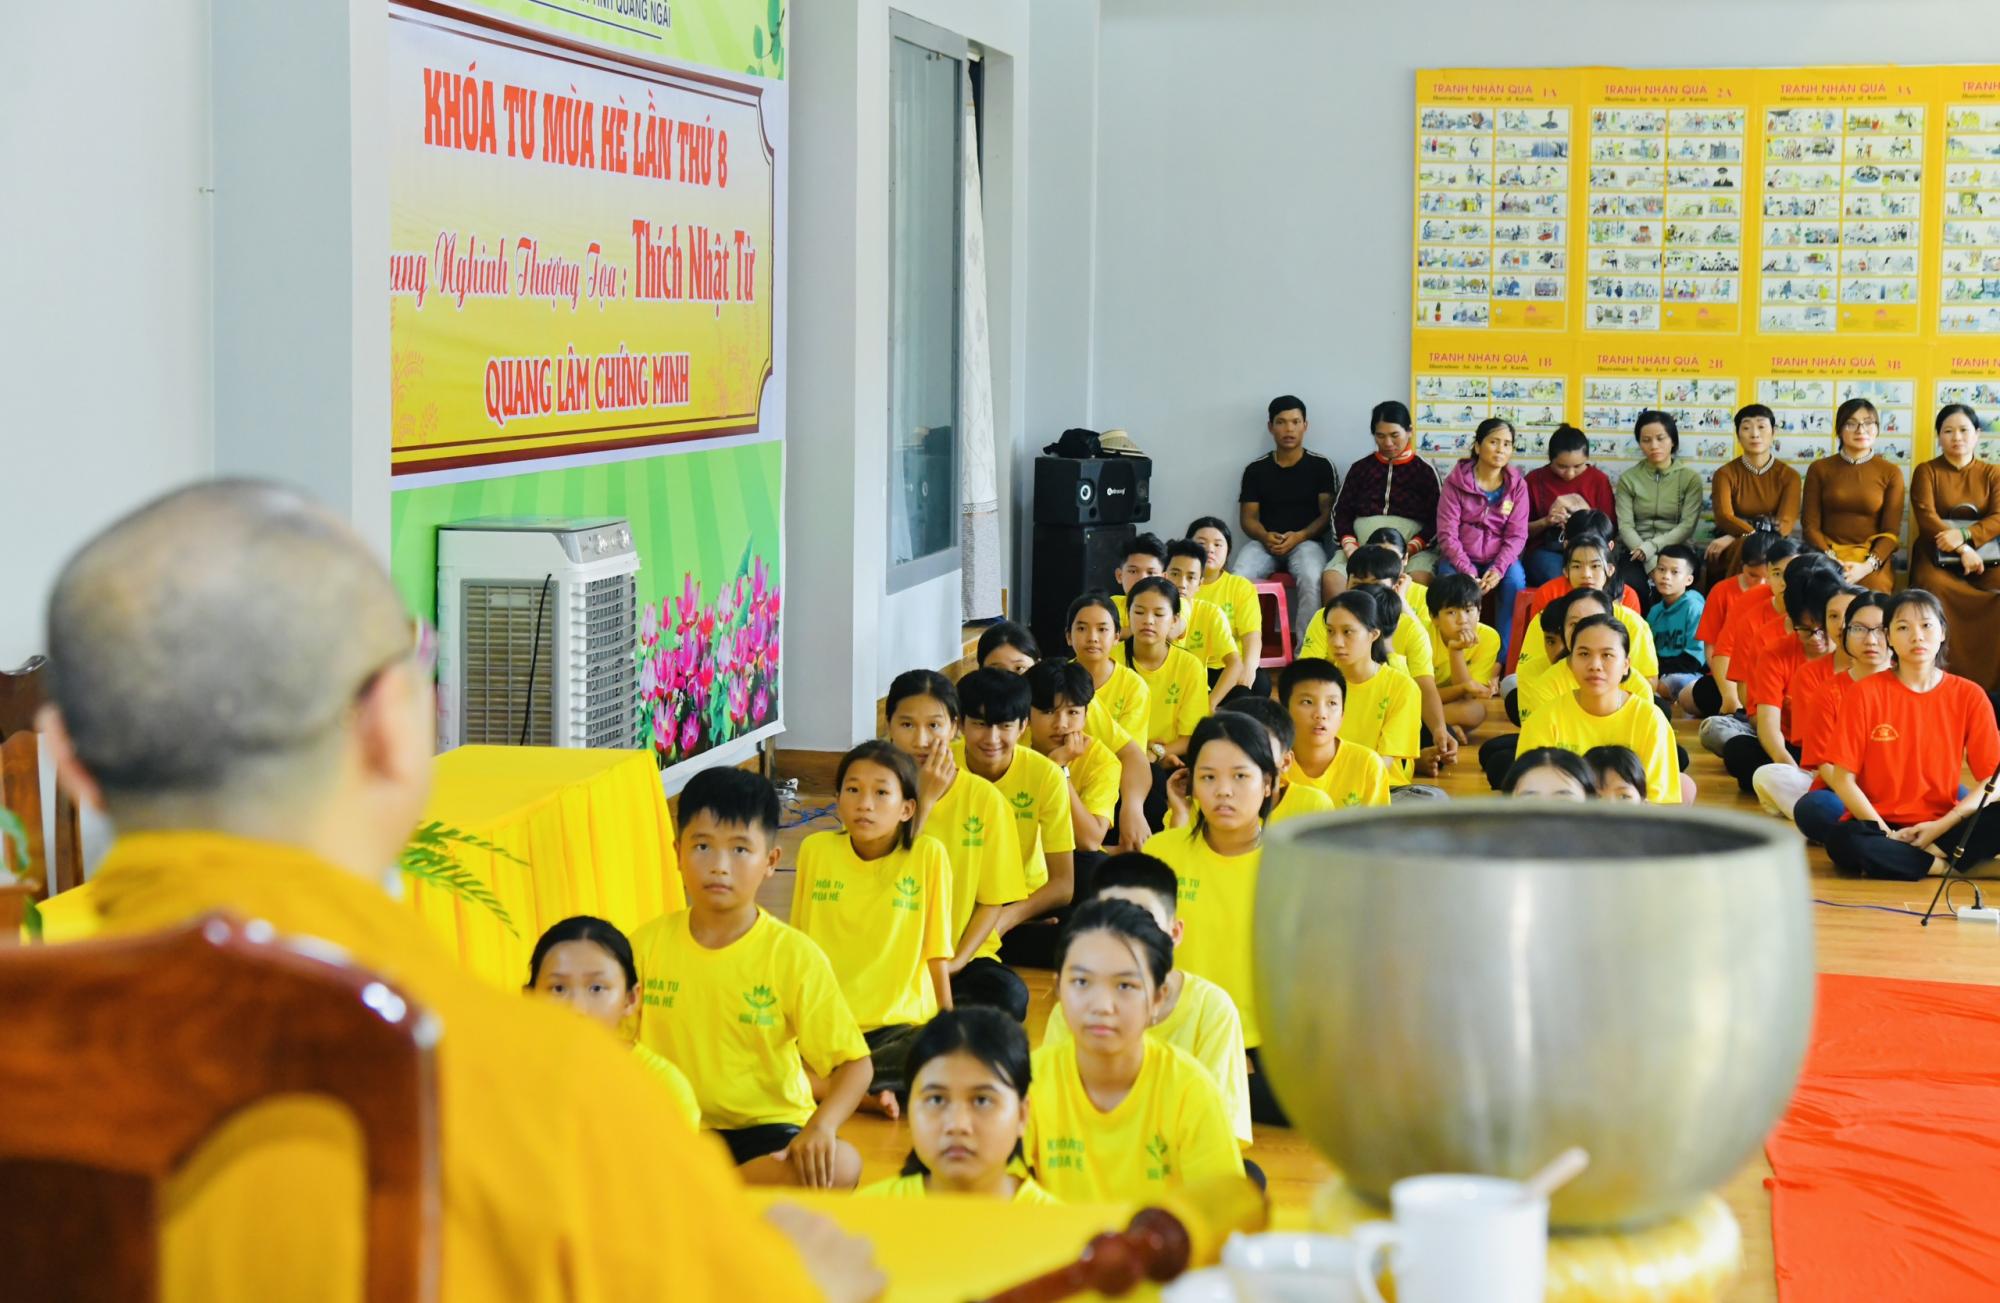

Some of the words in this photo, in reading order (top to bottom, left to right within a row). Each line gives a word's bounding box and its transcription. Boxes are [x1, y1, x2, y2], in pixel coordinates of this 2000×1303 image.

[1433, 84, 1468, 93] TRANH
[1605, 84, 1641, 94] TRANH
[1780, 84, 1817, 94] TRANH
[1962, 81, 2000, 91] TRANH
[423, 60, 497, 155] KHÓA
[503, 84, 536, 161] TU
[543, 83, 595, 170] MÙA
[601, 94, 627, 174] HÈ
[633, 88, 673, 181] LẦN
[677, 114, 715, 187] THỨ
[718, 129, 728, 189] 8
[435, 231, 509, 309] Nghinh
[587, 241, 617, 312] Tọa
[632, 218, 683, 299] Thích
[688, 225, 730, 319] Nhật
[1430, 353, 1464, 362] TRANH
[1598, 355, 1633, 365] TRANH
[1772, 357, 1808, 367] TRANH
[1952, 358, 1989, 368] TRANH
[485, 357, 552, 427] QUANG
[556, 345, 590, 413] LÂM
[594, 343, 649, 409] CHỨNG
[652, 354, 690, 406] MINH
